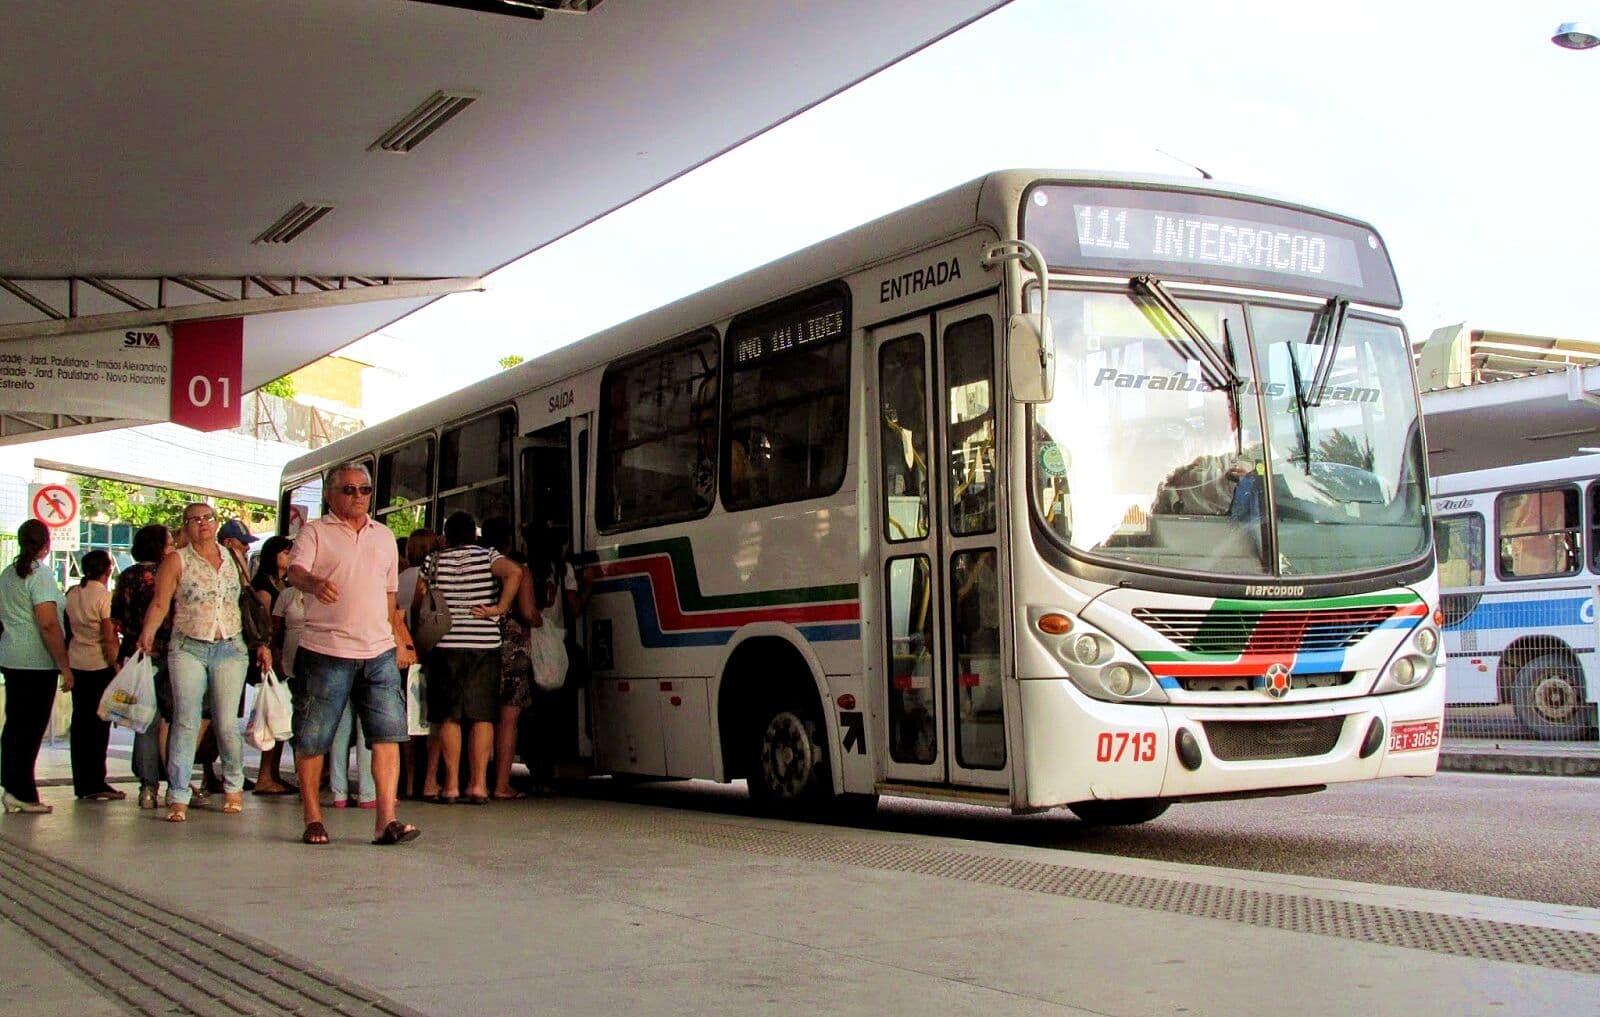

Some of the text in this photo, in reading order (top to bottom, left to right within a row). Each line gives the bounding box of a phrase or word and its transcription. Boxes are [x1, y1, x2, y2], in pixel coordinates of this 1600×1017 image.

[1079, 206, 1130, 250] 111
[880, 257, 961, 303] ENTRADA
[124, 331, 160, 346] SIVA
[51, 356, 90, 368] Paulistano
[123, 361, 168, 373] Alexandrino
[57, 368, 99, 381] Paulistano
[106, 372, 128, 383] Novo
[129, 373, 166, 385] Horizonte
[188, 375, 230, 408] 01
[1094, 367, 1214, 393] Paraíba
[1096, 731, 1156, 763] 0713
